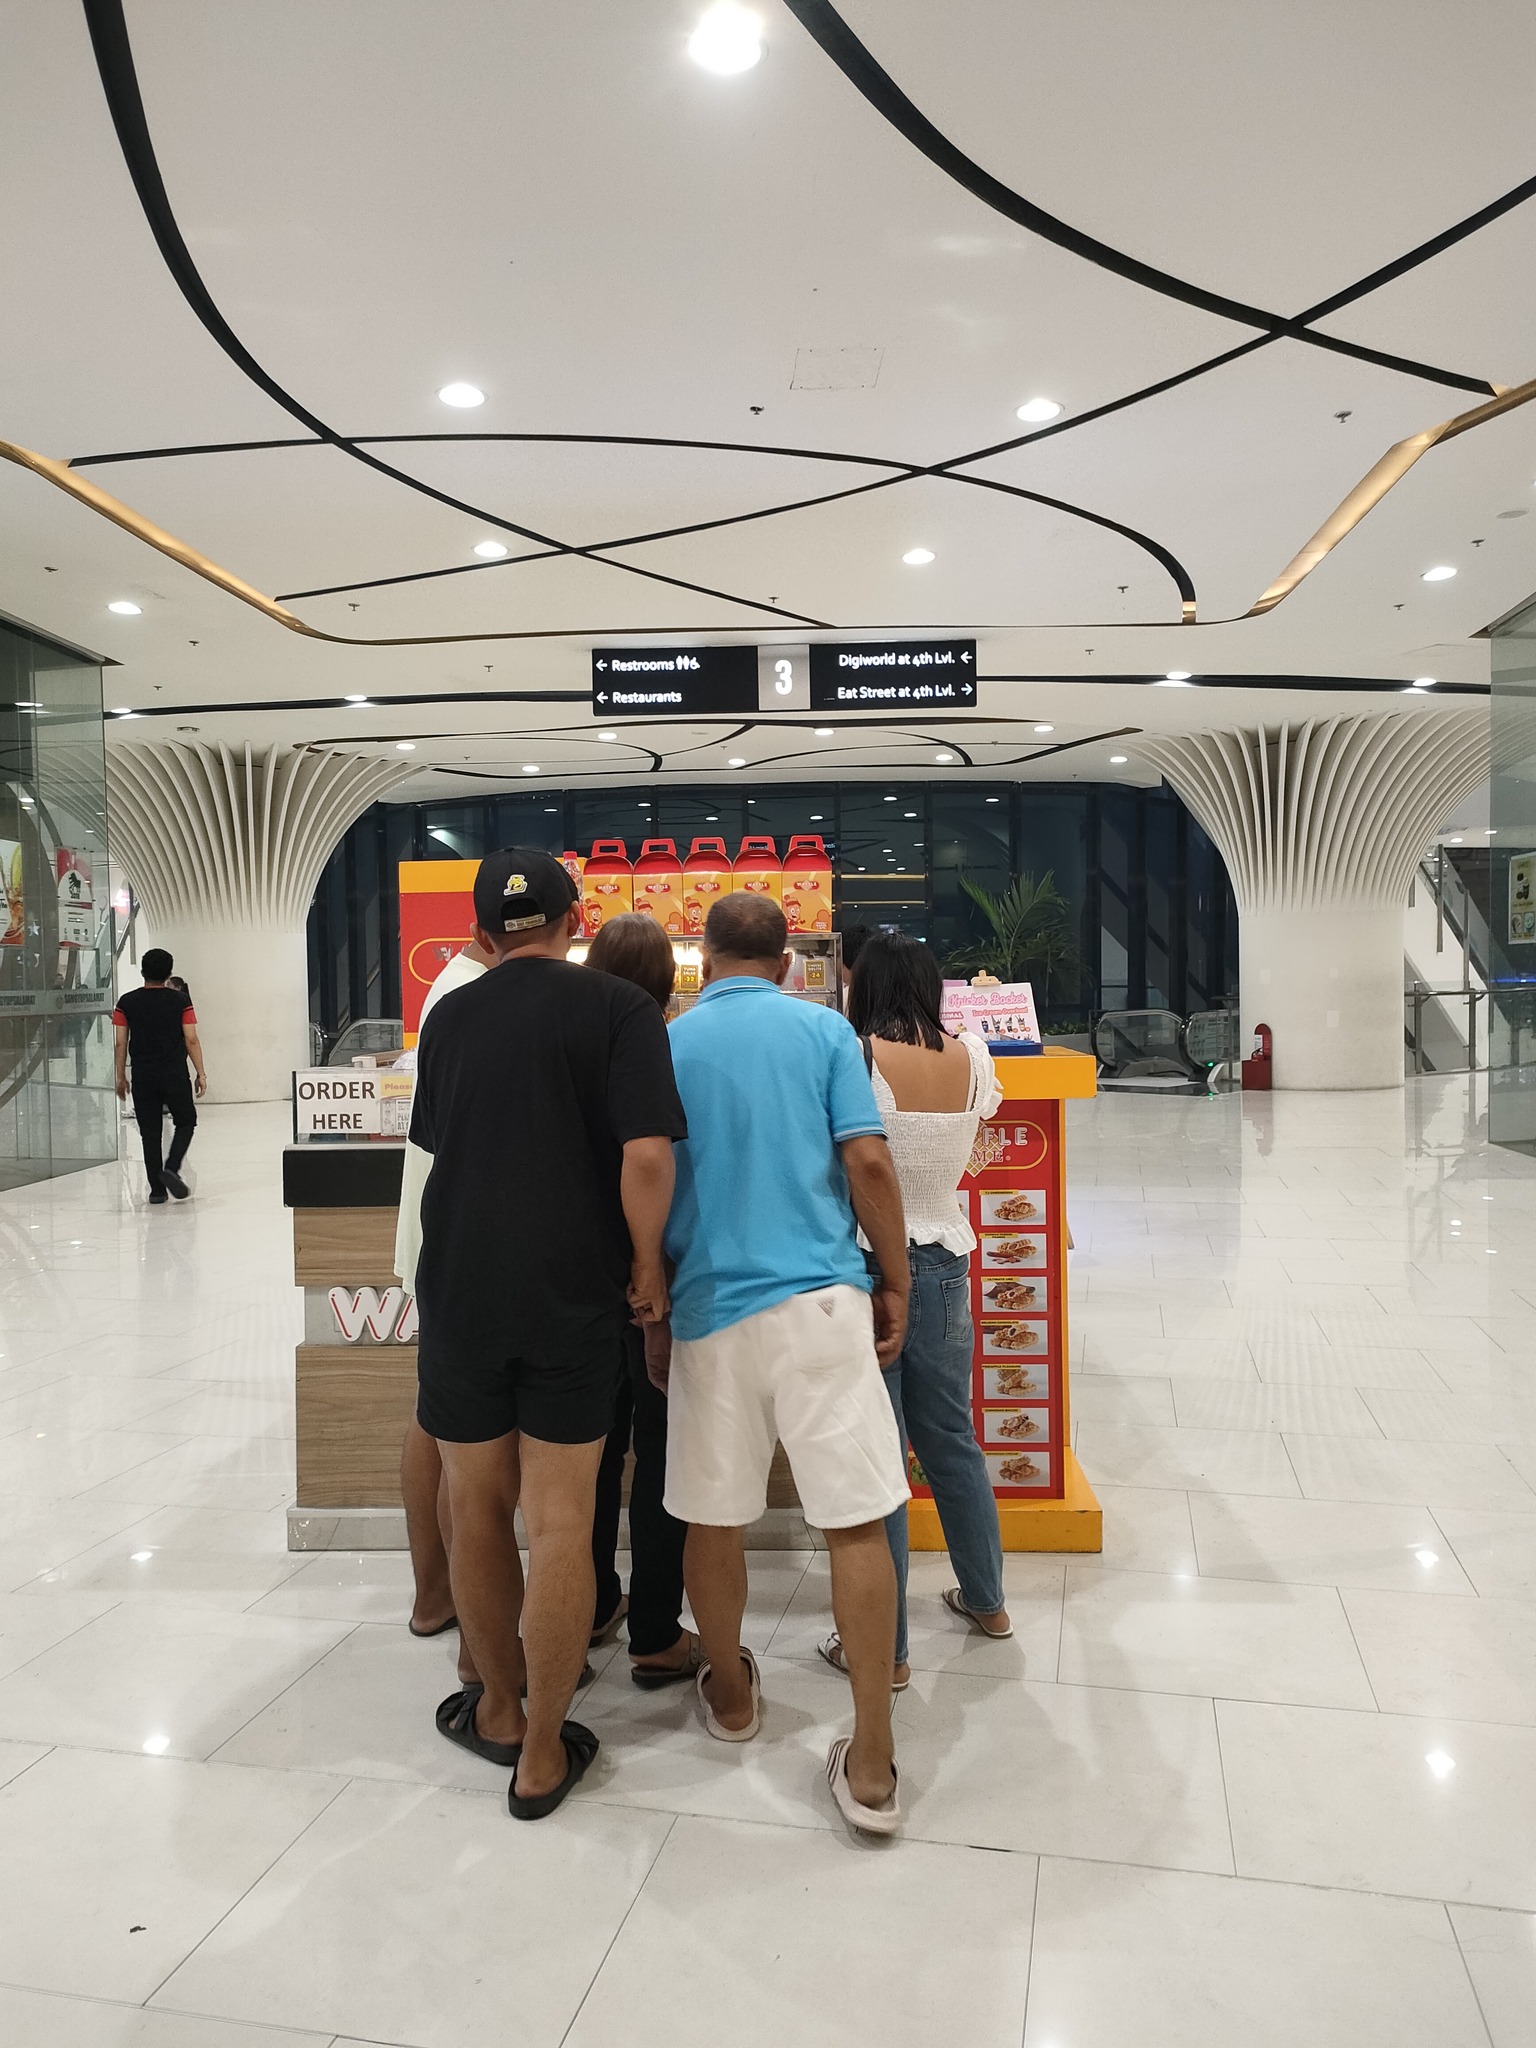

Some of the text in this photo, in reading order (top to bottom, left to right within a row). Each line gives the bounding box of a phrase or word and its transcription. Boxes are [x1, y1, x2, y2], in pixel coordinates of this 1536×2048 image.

[611, 659, 675, 671] Restrooms
[838, 651, 956, 669] Digiworld at 4th Lvl.
[774, 659, 793, 695] 3
[612, 691, 682, 703] Restaurants
[837, 683, 956, 700] Eat Street at 4th Lvl.
[948, 991, 1027, 1008] Knicker Bocker
[298, 1081, 376, 1100] ORDER
[312, 1113, 363, 1130] HERE
[983, 1127, 1028, 1146] FLE
[972, 1149, 1012, 1164] ME.
